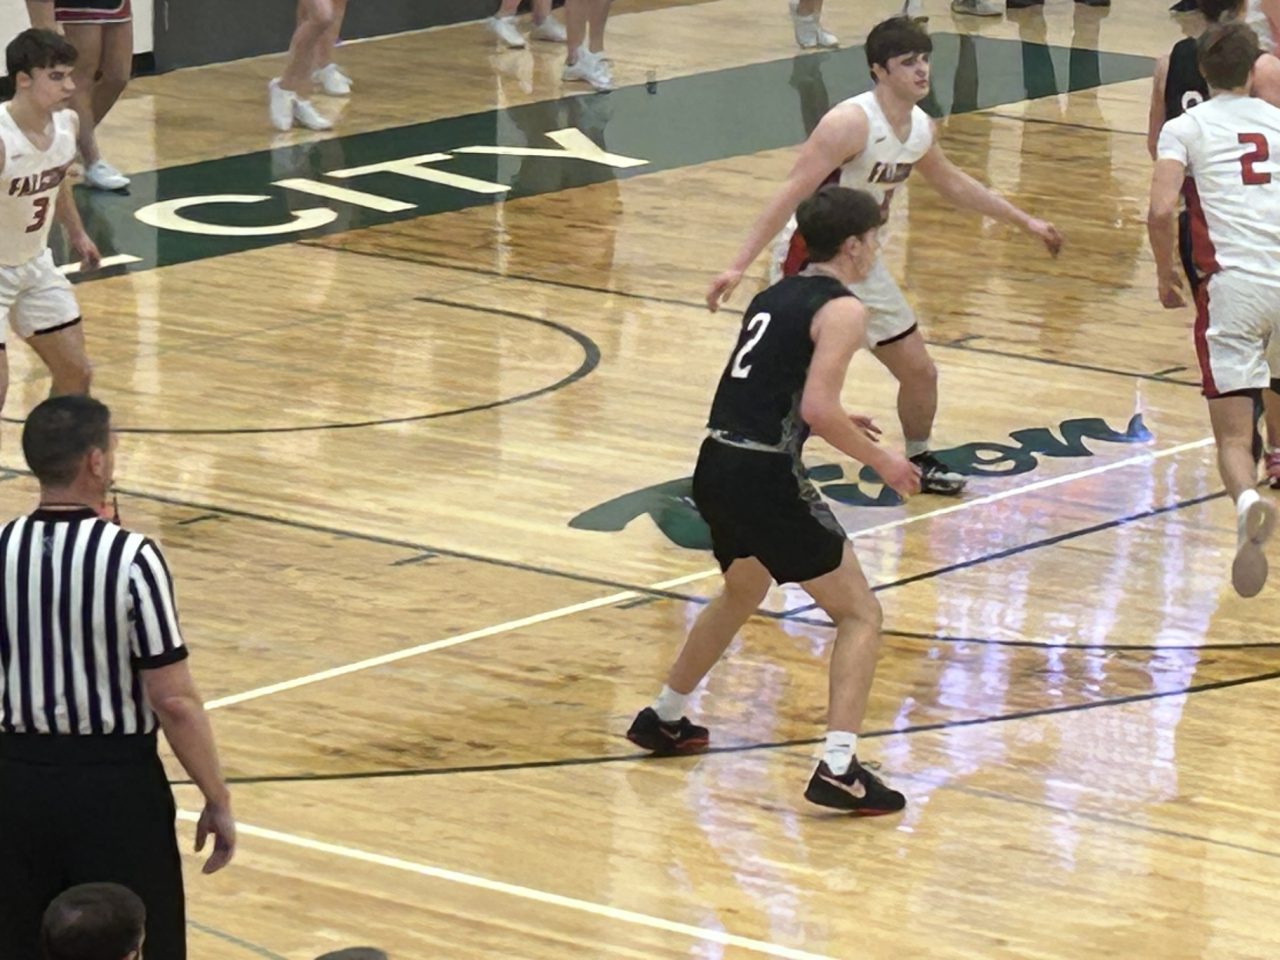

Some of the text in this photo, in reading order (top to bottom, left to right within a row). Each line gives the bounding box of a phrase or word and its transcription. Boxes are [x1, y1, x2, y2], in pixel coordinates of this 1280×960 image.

[134, 126, 651, 236] CITY
[1237, 132, 1272, 186] 2
[24, 196, 50, 234] 3
[731, 311, 772, 379] 2
